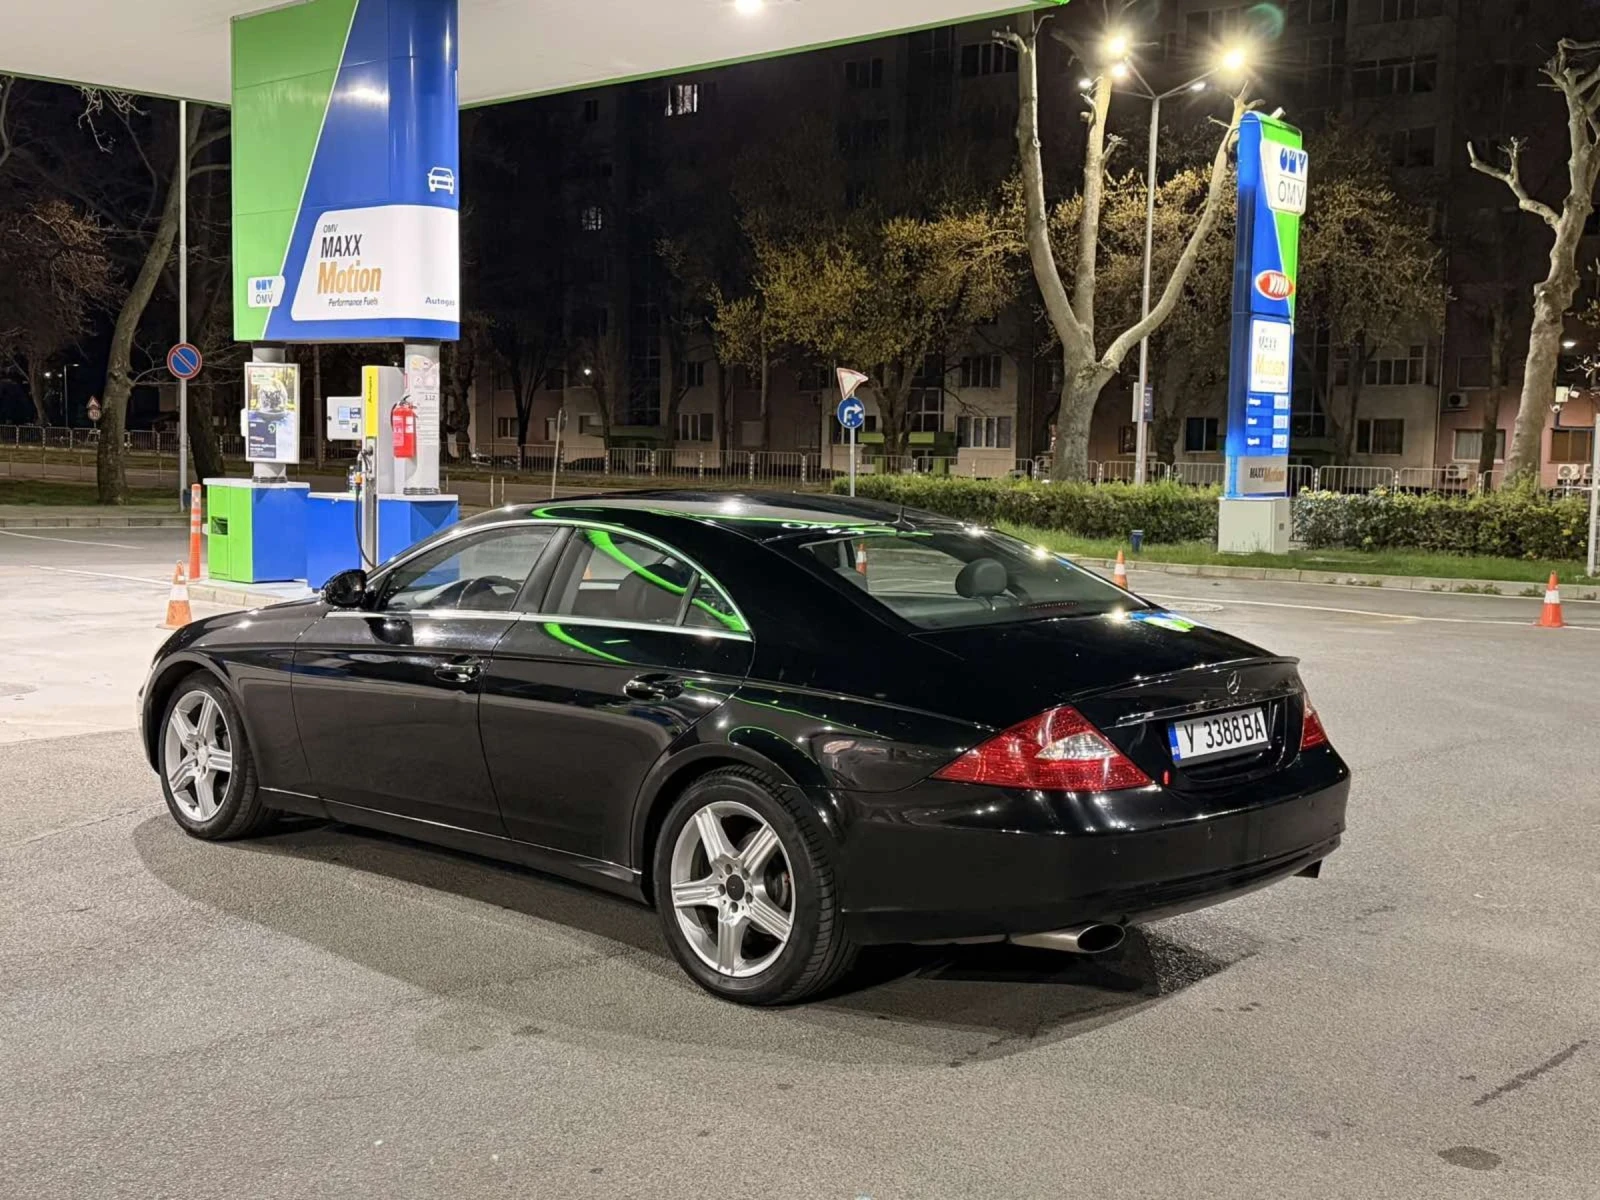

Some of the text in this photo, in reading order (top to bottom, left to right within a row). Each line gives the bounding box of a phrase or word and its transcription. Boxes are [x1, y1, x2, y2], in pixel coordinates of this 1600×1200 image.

[1278, 180, 1305, 206] OMV
[323, 223, 339, 233] OMV
[320, 233, 363, 258] MAXX
[317, 260, 382, 295] Motion
[255, 293, 273, 304] OMV
[328, 296, 379, 307] Performance Fuels
[425, 296, 455, 307] Autogas
[1184, 723, 1194, 753] Y
